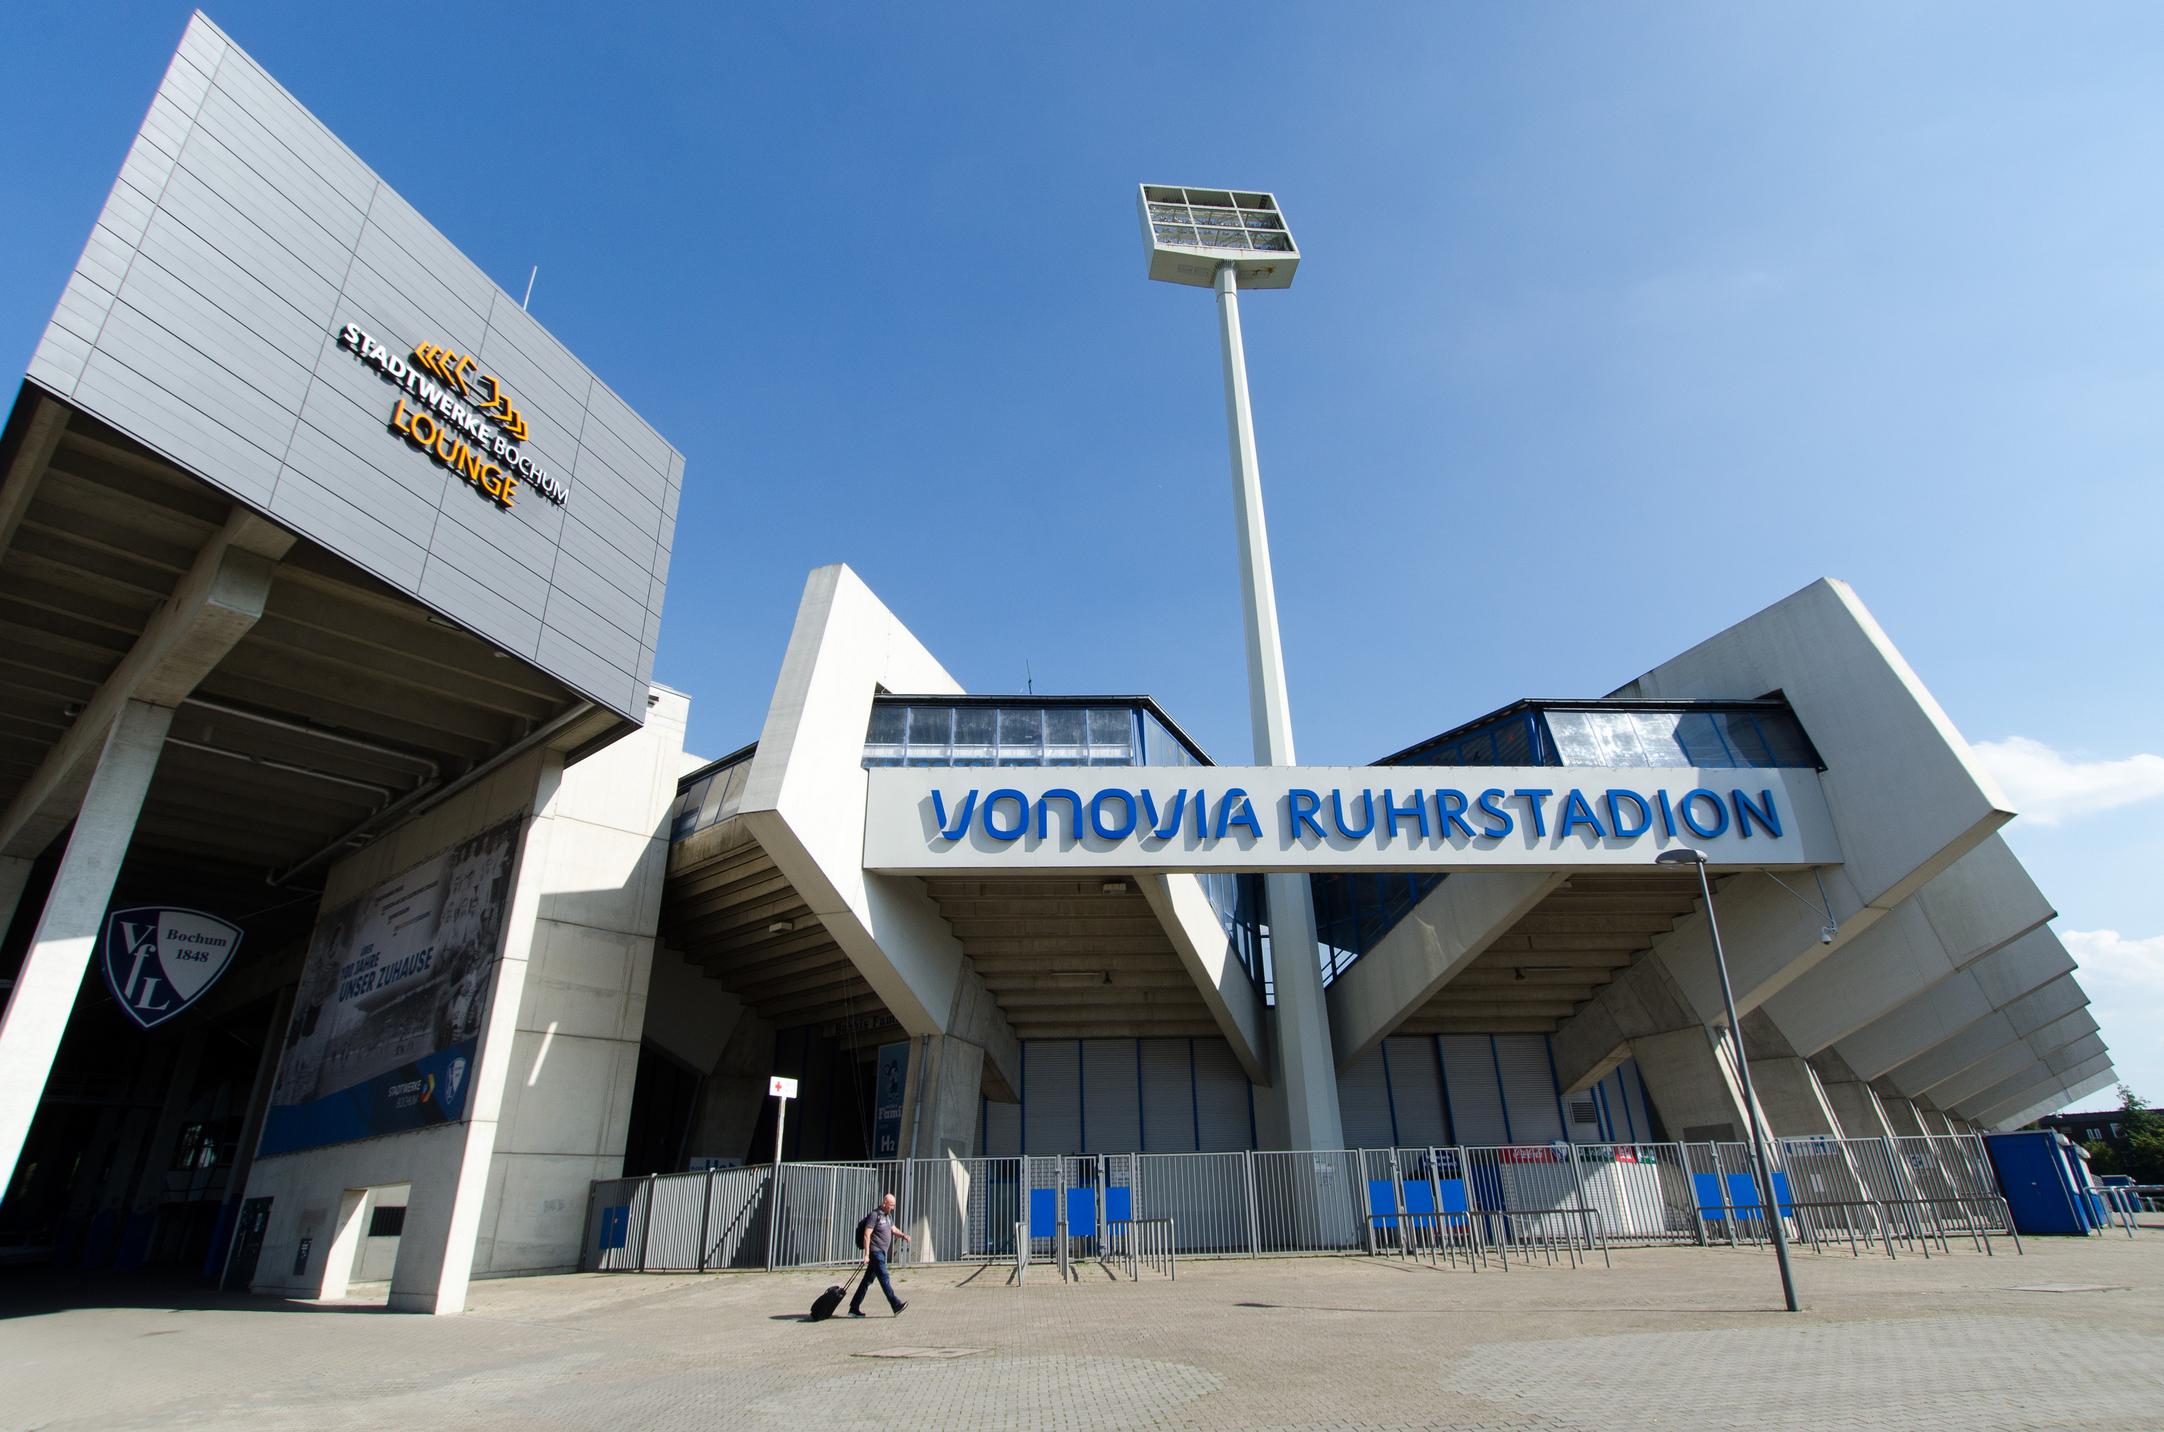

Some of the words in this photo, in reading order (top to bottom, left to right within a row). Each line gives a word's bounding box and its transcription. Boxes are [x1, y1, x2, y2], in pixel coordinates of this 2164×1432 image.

[341, 322, 491, 444] STADTWERKE
[494, 436, 569, 504] BOCHUM
[391, 398, 520, 508] LOUNGE
[1289, 788, 1783, 839] RUHRSTADION
[166, 928, 227, 947] Bochum
[176, 949, 209, 963] 1848
[354, 952, 380, 974] JAHRE
[120, 921, 171, 1011] VfL
[339, 970, 375, 1002] UNSER
[377, 947, 433, 986] ZUHAUSE
[881, 1136, 895, 1152] H2
